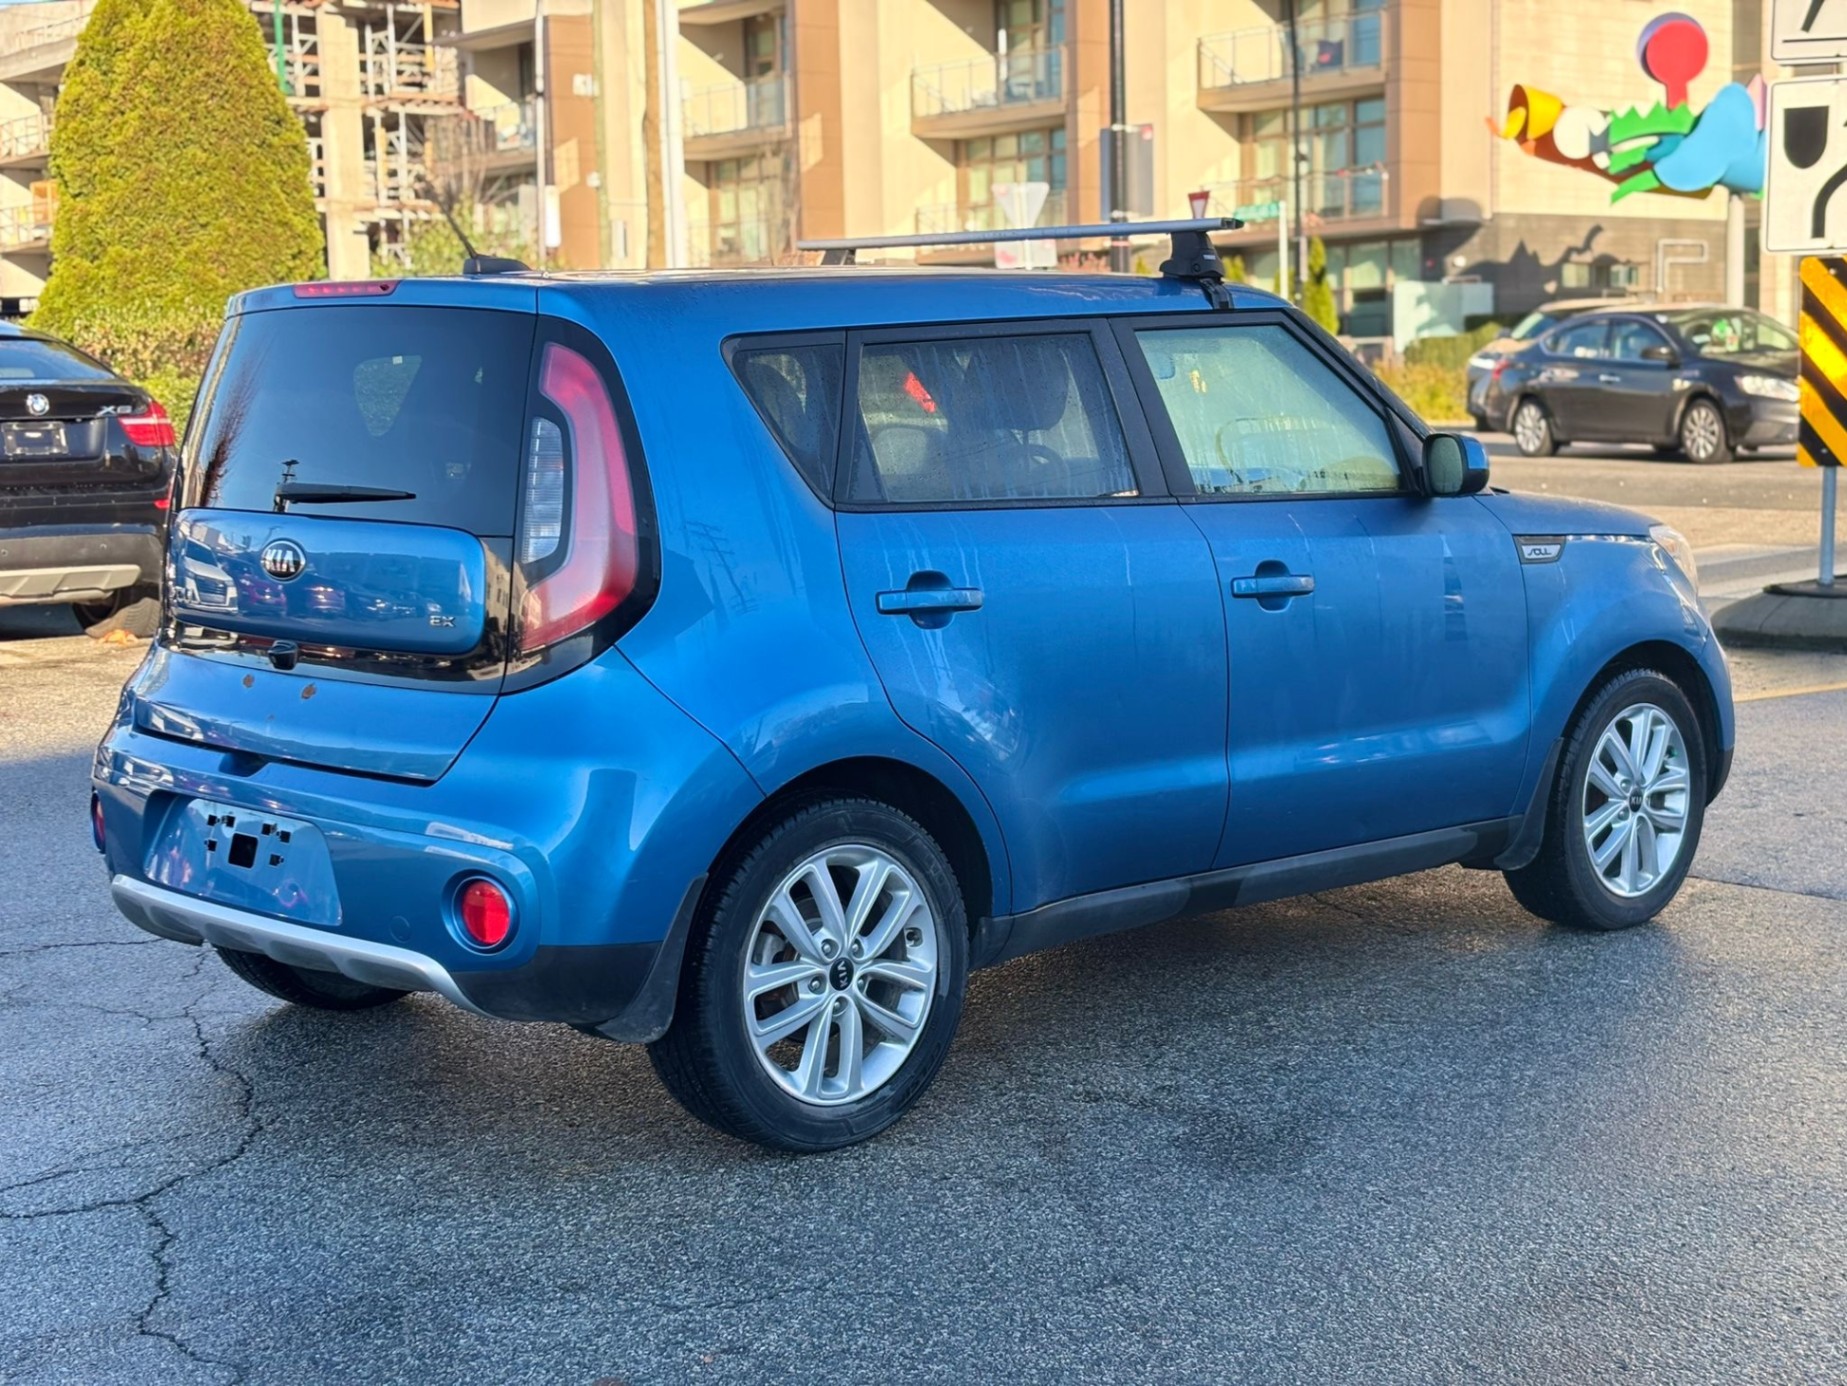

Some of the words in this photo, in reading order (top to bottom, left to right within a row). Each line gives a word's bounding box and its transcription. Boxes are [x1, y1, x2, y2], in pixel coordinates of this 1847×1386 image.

[265, 549, 296, 572] KIA
[430, 615, 455, 627] EX
[837, 960, 849, 988] KIA
